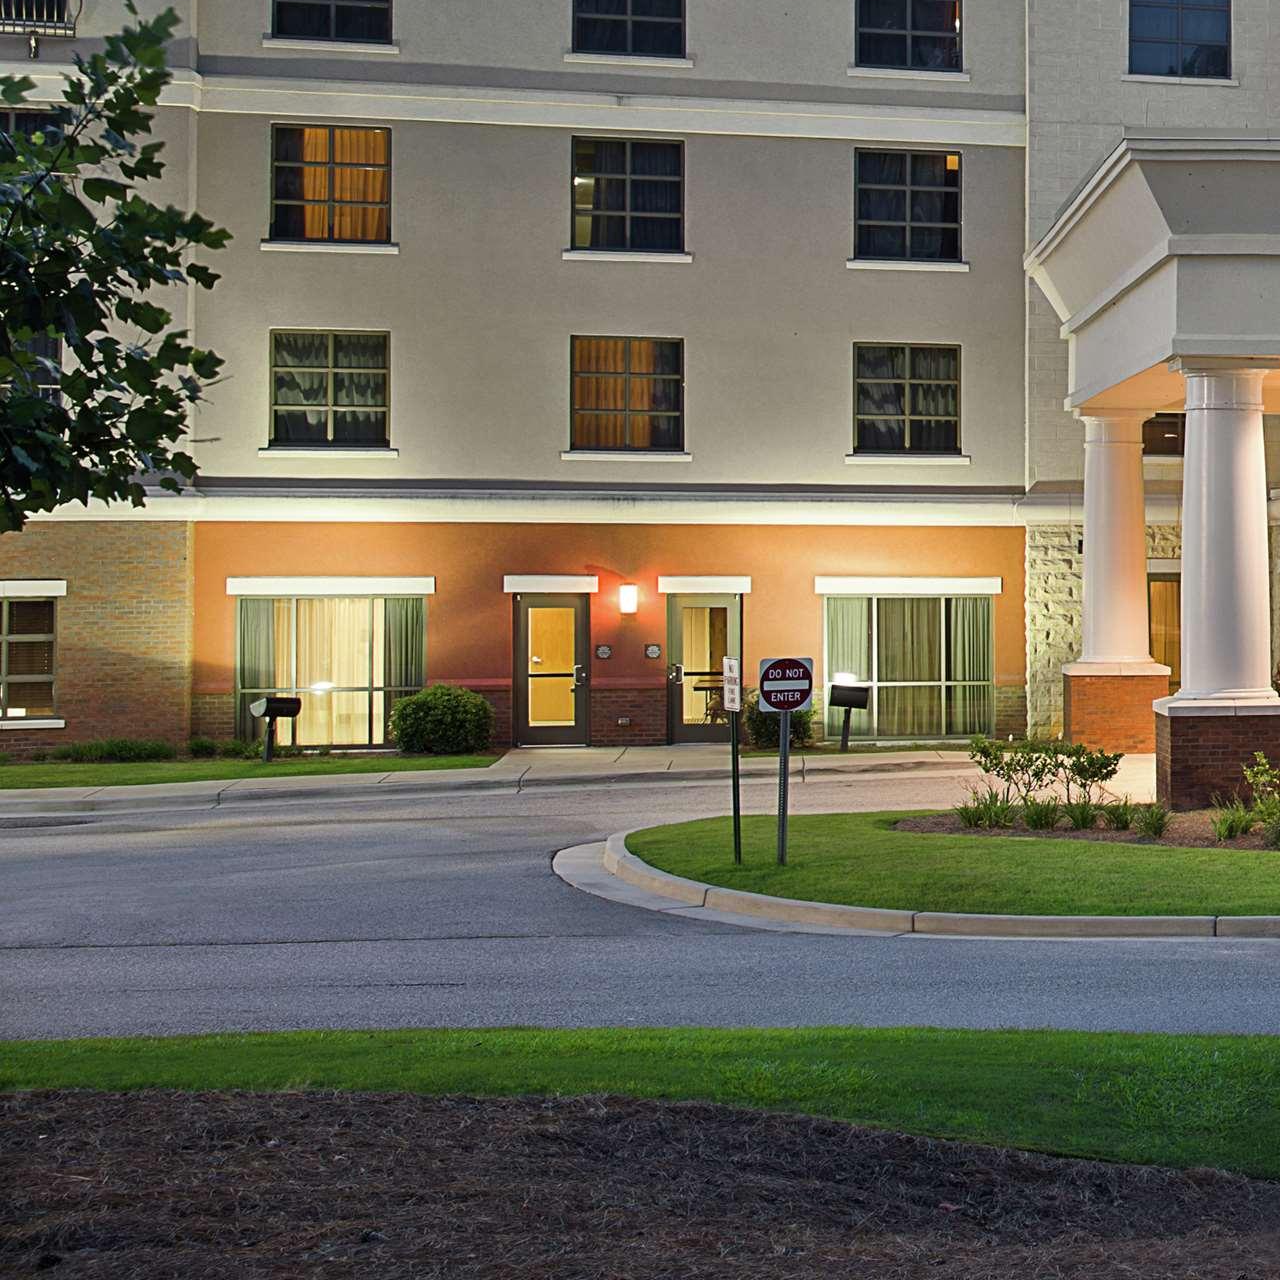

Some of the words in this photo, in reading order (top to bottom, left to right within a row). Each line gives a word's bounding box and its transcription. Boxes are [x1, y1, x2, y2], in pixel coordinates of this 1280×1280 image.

[768, 669, 782, 679] DO
[785, 668, 804, 678] NOT
[771, 691, 801, 702] ENTER
